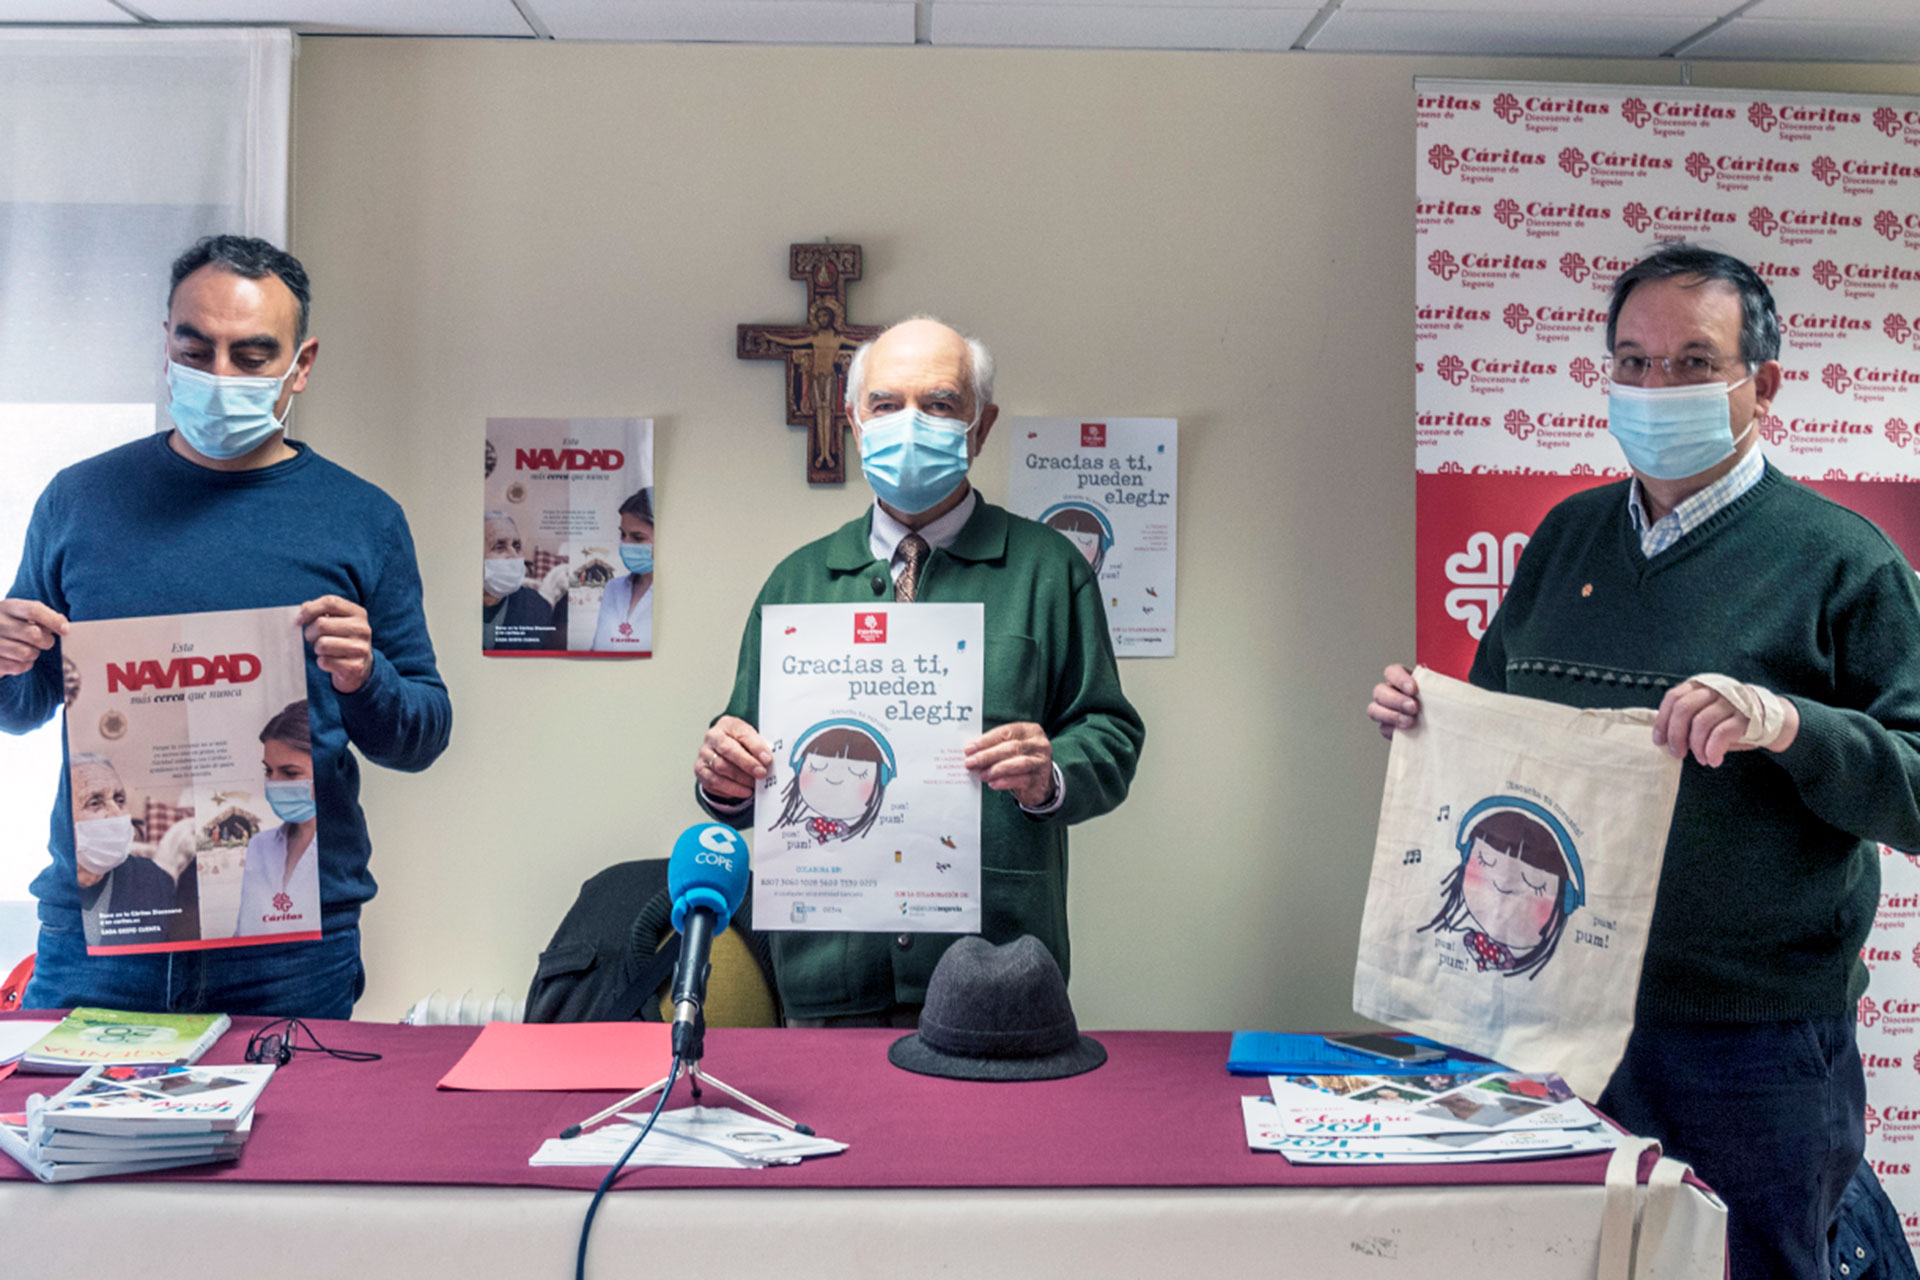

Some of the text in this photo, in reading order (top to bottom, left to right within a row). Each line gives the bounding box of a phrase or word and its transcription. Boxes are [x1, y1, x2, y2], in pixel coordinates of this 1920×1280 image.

[1417, 94, 1481, 110] ritas
[1525, 97, 1609, 114] Cáritas
[1653, 102, 1736, 119] Cáritas
[1779, 106, 1861, 123] Cáritas
[1574, 115, 1583, 123] de
[1526, 124, 1558, 133] Segovia
[1653, 128, 1685, 138] Segovia
[1780, 132, 1812, 142] Segovia
[1461, 148, 1546, 165] Cáritas
[1591, 152, 1673, 168] Cáritas
[1509, 166, 1519, 174] de
[1717, 156, 1799, 173] Cáritas
[1843, 160, 1920, 178] Cáritas
[1461, 174, 1494, 184] Segovia
[1591, 178, 1622, 187] Segovia
[1764, 174, 1773, 182] de
[1717, 182, 1748, 192] Segovia
[1843, 186, 1873, 196] Segovia
[1526, 202, 1611, 219] Cáritas
[1654, 206, 1736, 223] Cáritas
[1780, 210, 1862, 227] Cáritas
[1526, 228, 1559, 238] Segovia
[1701, 224, 1710, 232] de
[1780, 236, 1812, 246] Segovia
[1461, 253, 1546, 270] Cáritas
[1592, 256, 1640, 271] Cári
[1750, 262, 1800, 276] itas
[1510, 271, 1520, 279] de
[1844, 264, 1920, 281] Cáritas
[1461, 279, 1494, 290] Segovia
[1844, 290, 1875, 300] Segovia
[1416, 305, 1491, 321] áritas
[1536, 306, 1608, 322] Cárita
[1584, 324, 1594, 332] de
[1789, 313, 1872, 330] Cáritas
[1536, 333, 1569, 342] Segovia
[1789, 340, 1821, 350] Segovia
[1471, 358, 1556, 374] Cáritas
[1519, 376, 1529, 384] de
[1854, 367, 1920, 383] Cárita
[1471, 386, 1504, 395] Segovia
[1854, 394, 1884, 402] Segovia
[1416, 411, 1491, 427] áritas
[1537, 413, 1608, 428] Cárita
[1790, 418, 1873, 434] Cáritas
[1537, 439, 1570, 449] Segovia
[1790, 445, 1822, 454] Segovia
[515, 448, 624, 471] NAVIDAD
[1026, 454, 1104, 470] Gracias
[1110, 458, 1121, 470] a
[1078, 472, 1143, 488] pueden
[1105, 490, 1170, 507] elegir
[172, 643, 194, 653] Esta
[107, 653, 261, 693] NAVIDAD
[782, 655, 949, 676] Gracias a ti,
[130, 688, 242, 704] más cerca que nunca
[849, 677, 937, 700] pueden
[886, 701, 973, 724] elegir
[880, 813, 904, 825] pum!
[787, 839, 811, 849] pum!
[695, 852, 734, 872] COPE
[262, 913, 302, 922] Cáritas
[1592, 916, 1617, 931] pum!
[1435, 937, 1455, 951] pum!
[1575, 930, 1610, 949] pum!
[1438, 953, 1468, 971] pum!
[1882, 1026, 1913, 1036] Segovia
[1305, 1123, 1381, 1132] 2021
[1269, 1138, 1348, 1147] 2021
[1883, 1134, 1914, 1142] Segovia
